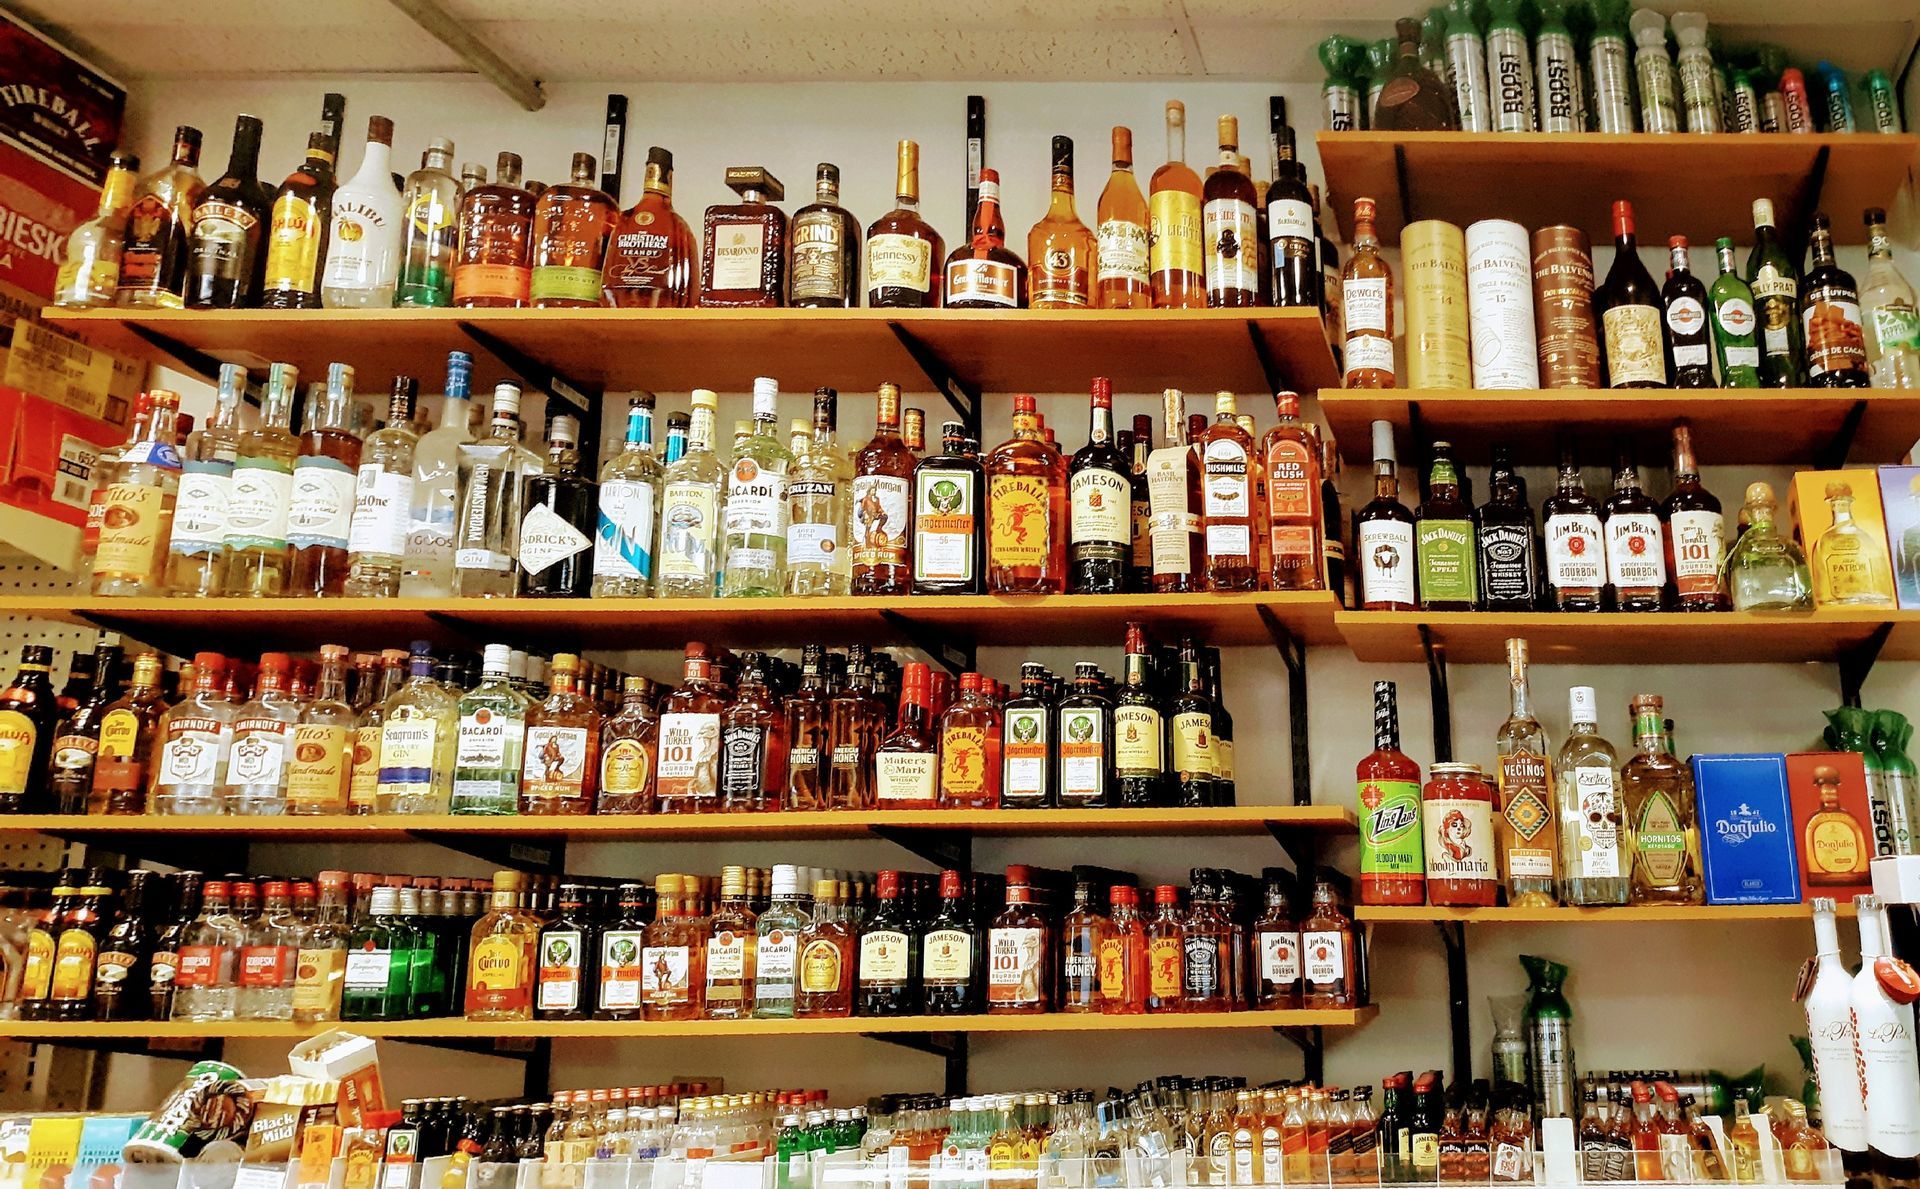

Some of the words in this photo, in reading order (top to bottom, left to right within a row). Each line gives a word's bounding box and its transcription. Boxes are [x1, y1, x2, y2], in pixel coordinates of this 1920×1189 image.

[794, 224, 839, 244] GRIND
[872, 249, 919, 264] Hennessy
[1051, 252, 1069, 269] 43
[1774, 282, 1793, 293] PRAT
[1345, 287, 1383, 301] Dewar's
[1495, 294, 1506, 303] 15
[78, 450, 97, 467] 652
[1205, 463, 1246, 473] BUSHMILLS
[1278, 463, 1300, 471] RED
[1273, 470, 1304, 479] BUSH
[788, 483, 834, 496] CRUZAN
[1071, 474, 1124, 494] JAMESON
[108, 487, 151, 503] Tito's
[669, 490, 705, 499] BARTON
[993, 481, 1045, 502] FIREBALL
[1421, 529, 1439, 545] JACK
[1438, 527, 1467, 545] DANIEL'S
[1553, 525, 1570, 541] JIM
[1571, 521, 1597, 540] BEAM
[1614, 525, 1630, 541] JIM
[1632, 521, 1658, 540] BEAM
[1364, 532, 1408, 543] SKREWBALL
[1481, 531, 1498, 548] JACK
[1498, 529, 1528, 549] DANIEL'S
[1680, 544, 1711, 561] 101
[1560, 567, 1597, 577] BOURBON
[1620, 567, 1658, 577] BOURBON
[169, 719, 216, 731] SMIRNOFF
[235, 719, 281, 731] SMIRNOFF
[461, 725, 503, 736] BACARDÍ
[296, 727, 333, 741] Tito's
[385, 728, 429, 745] Seagram's
[669, 727, 689, 737] WILD
[664, 735, 693, 746] TURKEY
[946, 731, 985, 746] FIREBALL
[393, 750, 410, 758] GIN
[663, 746, 693, 762] 101
[790, 753, 817, 764] HONEY
[833, 753, 860, 763] HONEY
[884, 756, 927, 765] Maker's
[895, 764, 927, 775] Mark
[1504, 764, 1545, 778] VECINOS
[1640, 834, 1681, 844] HORNITOS
[1459, 858, 1489, 873] maria
[864, 934, 903, 946] JAMESON
[928, 933, 966, 945] JAMESON
[998, 938, 1015, 947] WILD
[1280, 936, 1296, 949] BEAM
[760, 945, 792, 954] BACARDÍ
[993, 946, 1018, 955] TURKEY
[478, 956, 510, 970] Cuervo
[993, 955, 1020, 970] 101
[1065, 956, 1096, 964] AMERICAN
[1064, 964, 1097, 977] HONEY
[253, 1113, 296, 1133] Black
[260, 1126, 293, 1145] Mild
